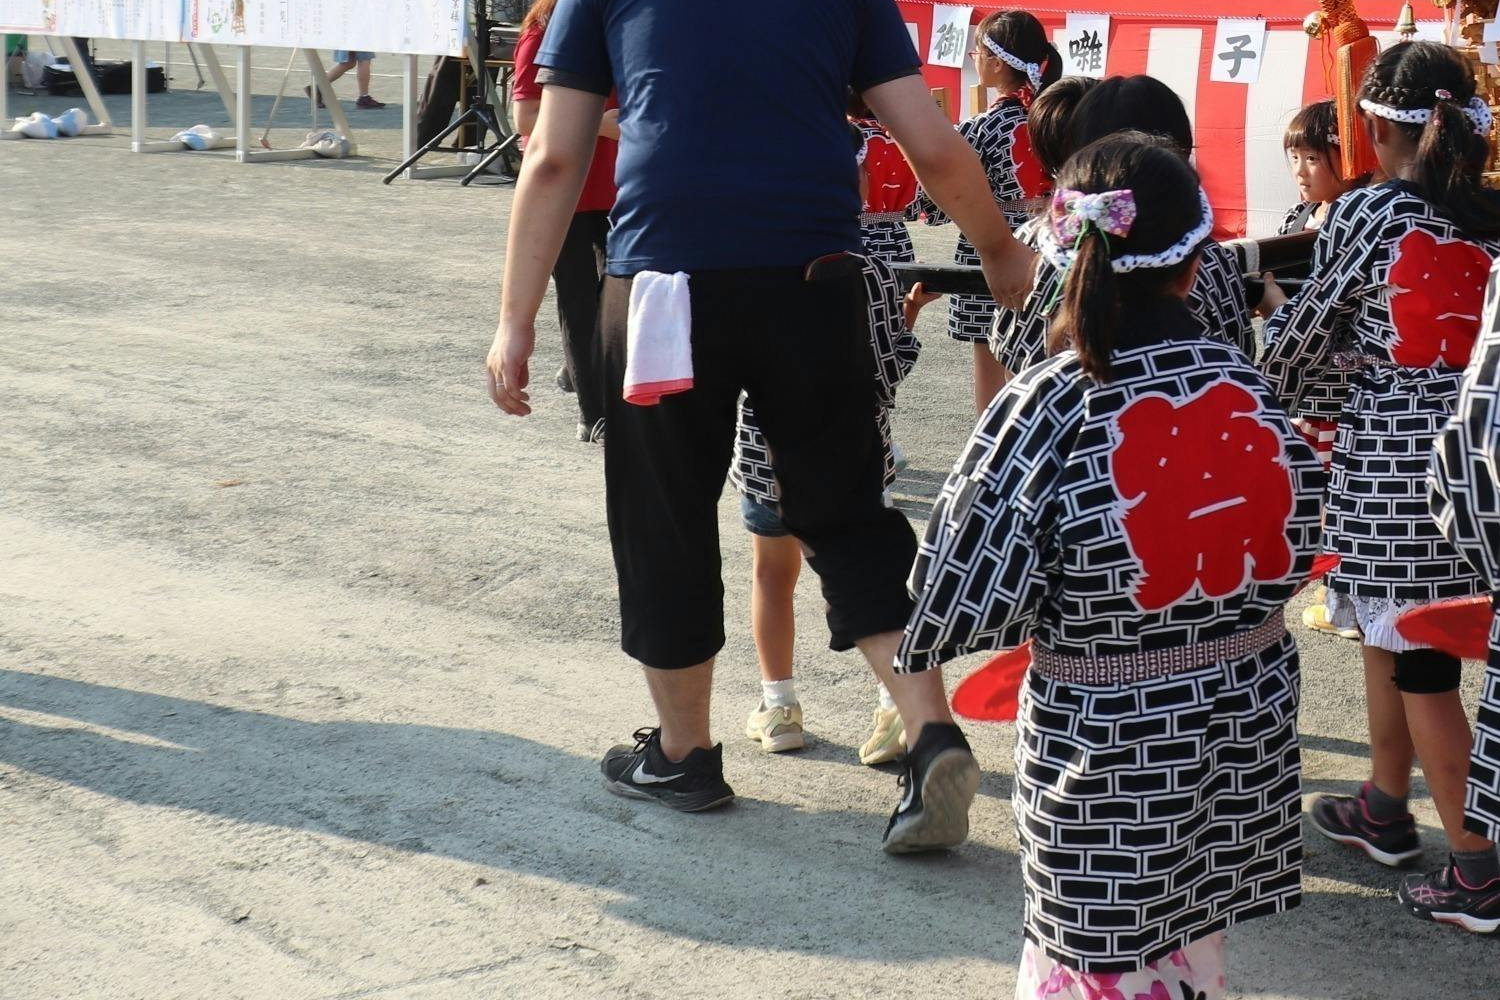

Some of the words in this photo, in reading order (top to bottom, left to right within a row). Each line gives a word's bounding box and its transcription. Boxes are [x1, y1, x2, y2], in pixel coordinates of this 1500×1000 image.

[933, 21, 965, 64] 御
[1069, 29, 1103, 73] 囃
[1217, 34, 1257, 79] 子
